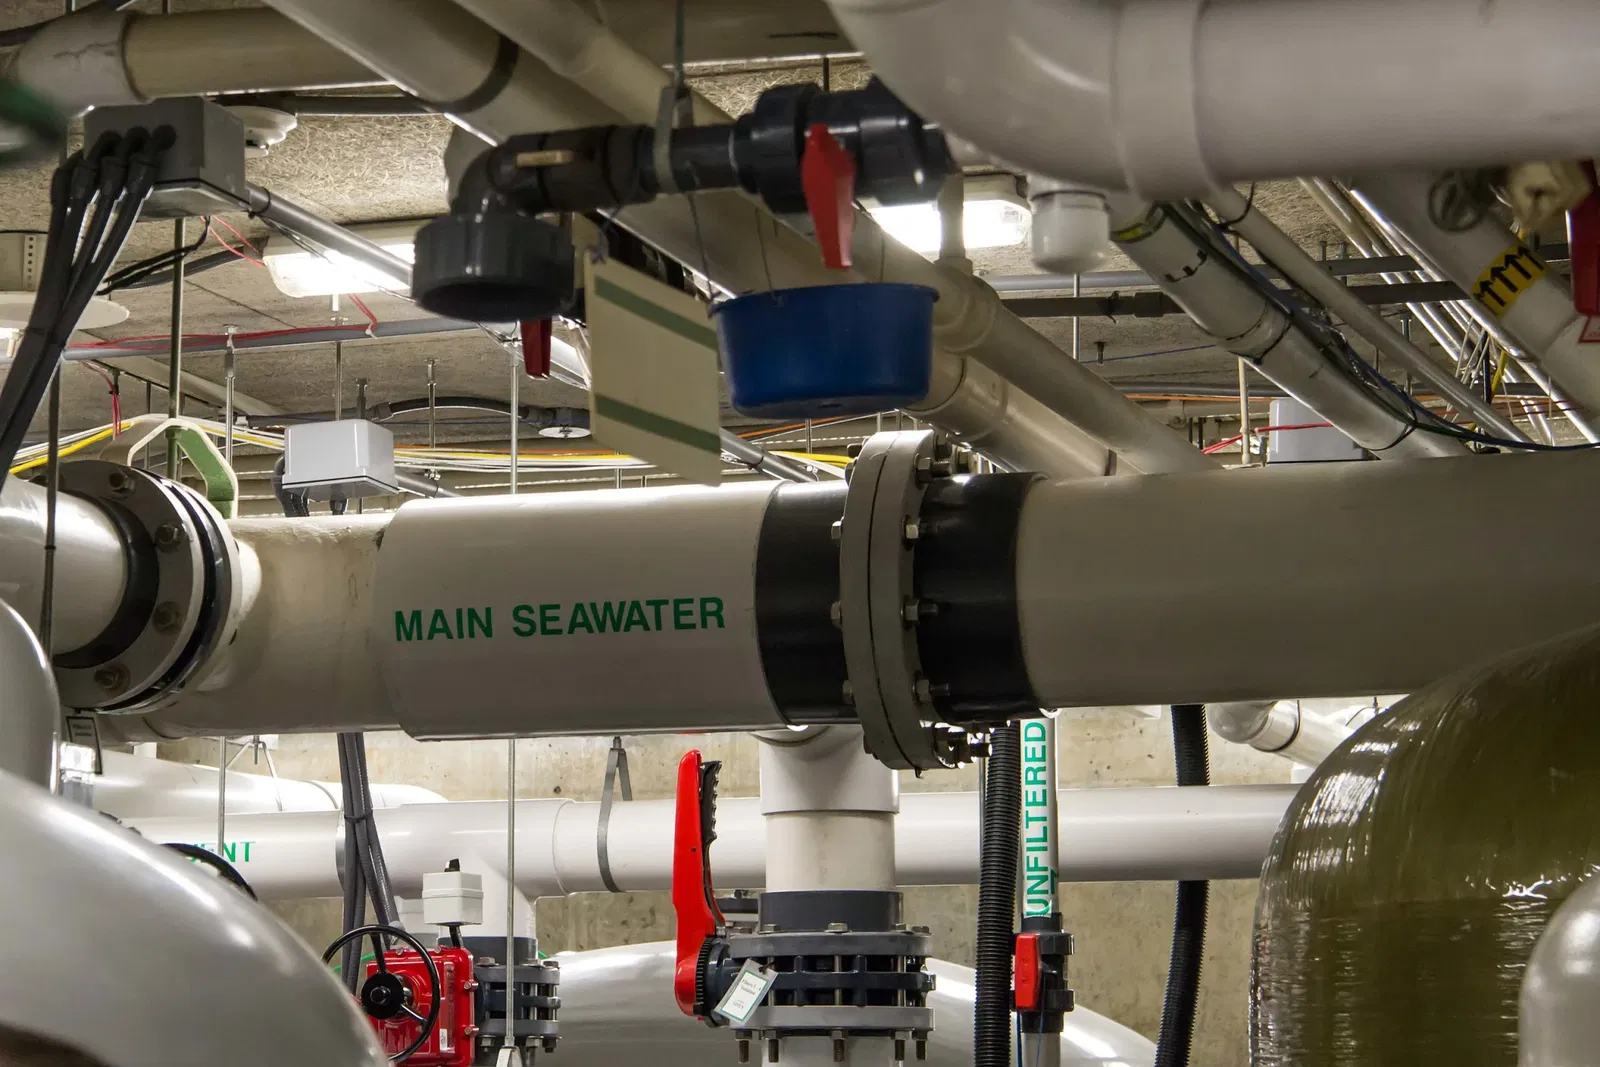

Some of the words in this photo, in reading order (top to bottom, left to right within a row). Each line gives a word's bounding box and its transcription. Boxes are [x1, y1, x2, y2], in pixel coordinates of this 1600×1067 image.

[395, 607, 493, 641] MAIN
[512, 596, 725, 637] SEAWATER
[1024, 720, 1050, 917] UNFILTERED
